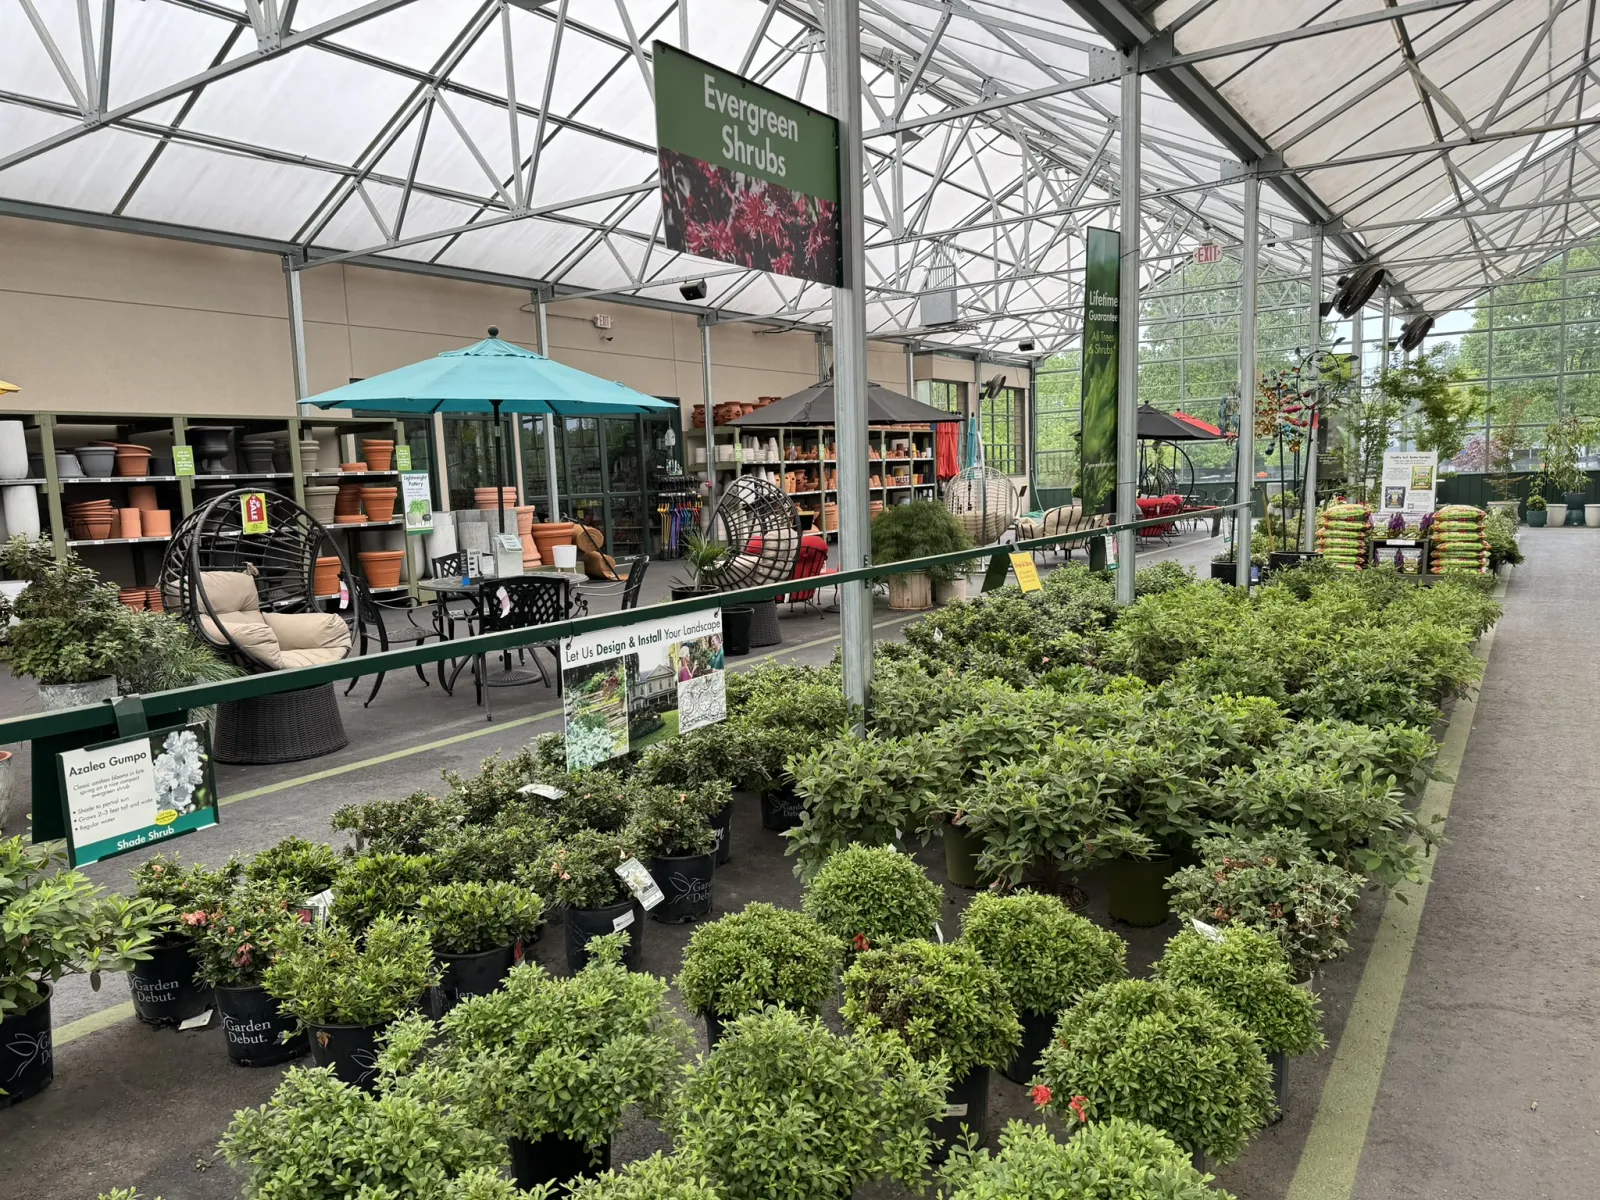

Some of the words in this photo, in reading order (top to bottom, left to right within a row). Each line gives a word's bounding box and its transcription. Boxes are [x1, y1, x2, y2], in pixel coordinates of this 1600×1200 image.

[704, 73, 798, 142] Evergreen
[722, 125, 786, 177] Shrubs
[1198, 245, 1218, 262] EXIT
[1089, 290, 1118, 307] Lifetime
[1088, 310, 1118, 322] Guarantee
[1091, 331, 1100, 341] All
[1100, 331, 1115, 342] Trees
[250, 500, 258, 520] SALE
[566, 651, 580, 663] Let
[582, 647, 594, 659] Us
[596, 641, 626, 656] Design
[629, 637, 636, 648] &
[638, 629, 662, 646] Install
[664, 628, 681, 640] Your
[683, 619, 720, 636] Landscape
[69, 761, 106, 777] Azalea
[109, 752, 147, 766] Gumpo
[73, 782, 90, 791] Classic
[92, 777, 110, 786] azaleas
[112, 773, 128, 781] blooms
[80, 788, 95, 796] spring
[120, 776, 140, 785] compact
[92, 788, 116, 798] evergreen
[78, 806, 94, 814] Shade
[102, 798, 119, 809] partial
[78, 814, 96, 823] Grows
[80, 821, 99, 830] Regular
[117, 834, 146, 850] Shade
[148, 826, 174, 841] Shrub
[693, 882, 711, 892] Gar
[134, 980, 179, 992] Garden
[137, 991, 176, 1002] Debut.
[225, 1020, 272, 1032] Garden
[228, 1032, 268, 1045] Debut.
